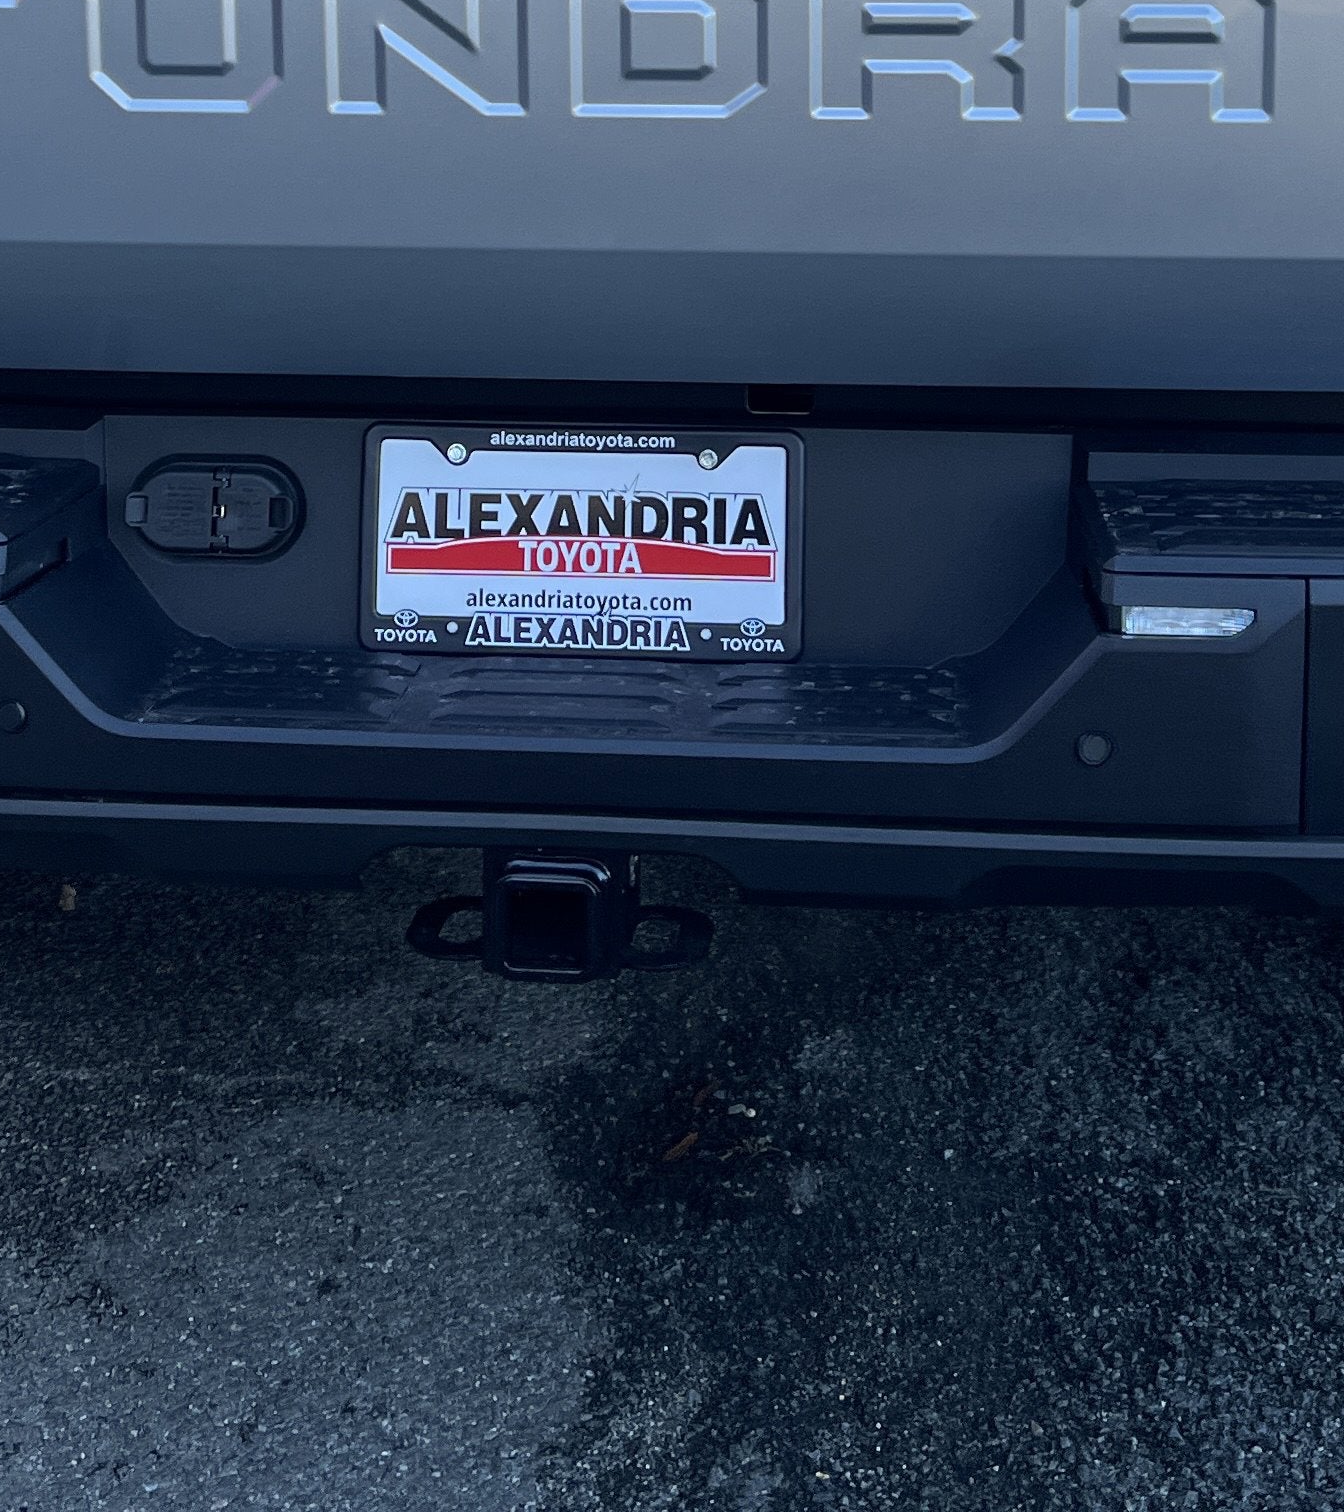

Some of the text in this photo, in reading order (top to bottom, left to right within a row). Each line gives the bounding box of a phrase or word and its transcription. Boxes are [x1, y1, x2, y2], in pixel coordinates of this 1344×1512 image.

[490, 431, 676, 450] alexandriatoyota.com
[391, 491, 771, 546] ALEXANDRIA
[518, 539, 643, 574] TOYOTA
[466, 589, 693, 612] alexandriatoyota.com
[374, 629, 437, 644] TOYOTA
[466, 613, 691, 651] ALEXANDRIA
[720, 636, 785, 653] TOYOTA
